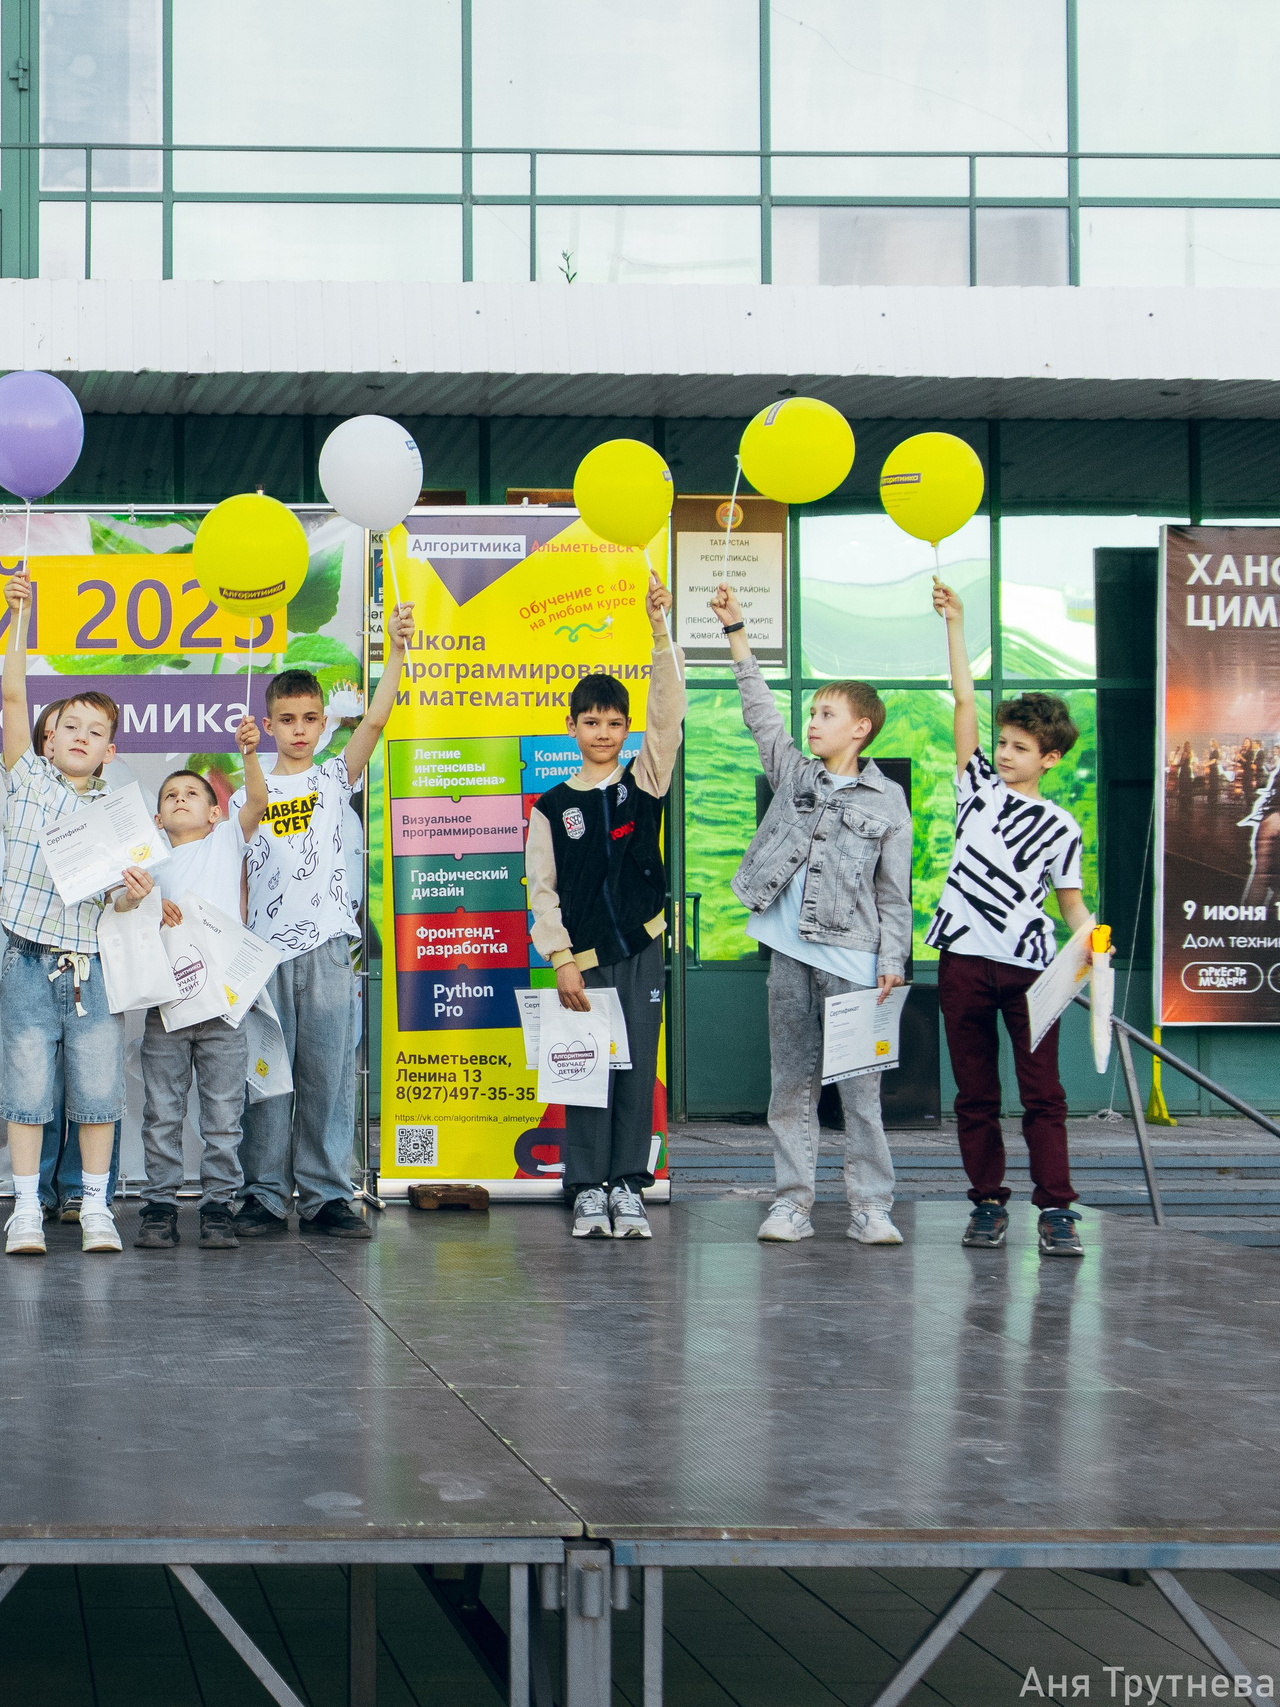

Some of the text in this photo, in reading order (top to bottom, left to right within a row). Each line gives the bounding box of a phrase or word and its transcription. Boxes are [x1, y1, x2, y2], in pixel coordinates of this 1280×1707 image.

[412, 539, 634, 555] Алгоритмика Альметьевск
[739, 585, 771, 593] РАЙОНЫ
[519, 586, 592, 620] Обучение
[596, 584, 605, 594] с
[529, 597, 637, 632] на любом курсе
[1186, 594, 1280, 631] ЦИМ
[396, 690, 572, 707] и математик
[414, 748, 461, 760] Летние
[414, 762, 486, 774] интенсивы
[412, 775, 505, 788] «Нейросмена»
[402, 814, 472, 826] Визуальное
[46, 822, 88, 846] Сертификат
[402, 825, 518, 840] программирование
[411, 867, 509, 883] Графический
[412, 885, 464, 899] дизайн
[1182, 900, 1197, 920] 9
[1203, 905, 1267, 921] июня
[415, 926, 501, 940] Фронтенд-
[1182, 933, 1280, 949] Дом техни
[417, 941, 508, 958] разработка
[433, 982, 494, 1002] Python
[434, 1004, 463, 1017] Pro
[396, 1051, 512, 1067] Альметьевск,
[553, 1052, 593, 1061] Алгоритмика
[396, 1069, 482, 1082] Ленина 13
[396, 1085, 535, 1103] 8(927)497-35-35
